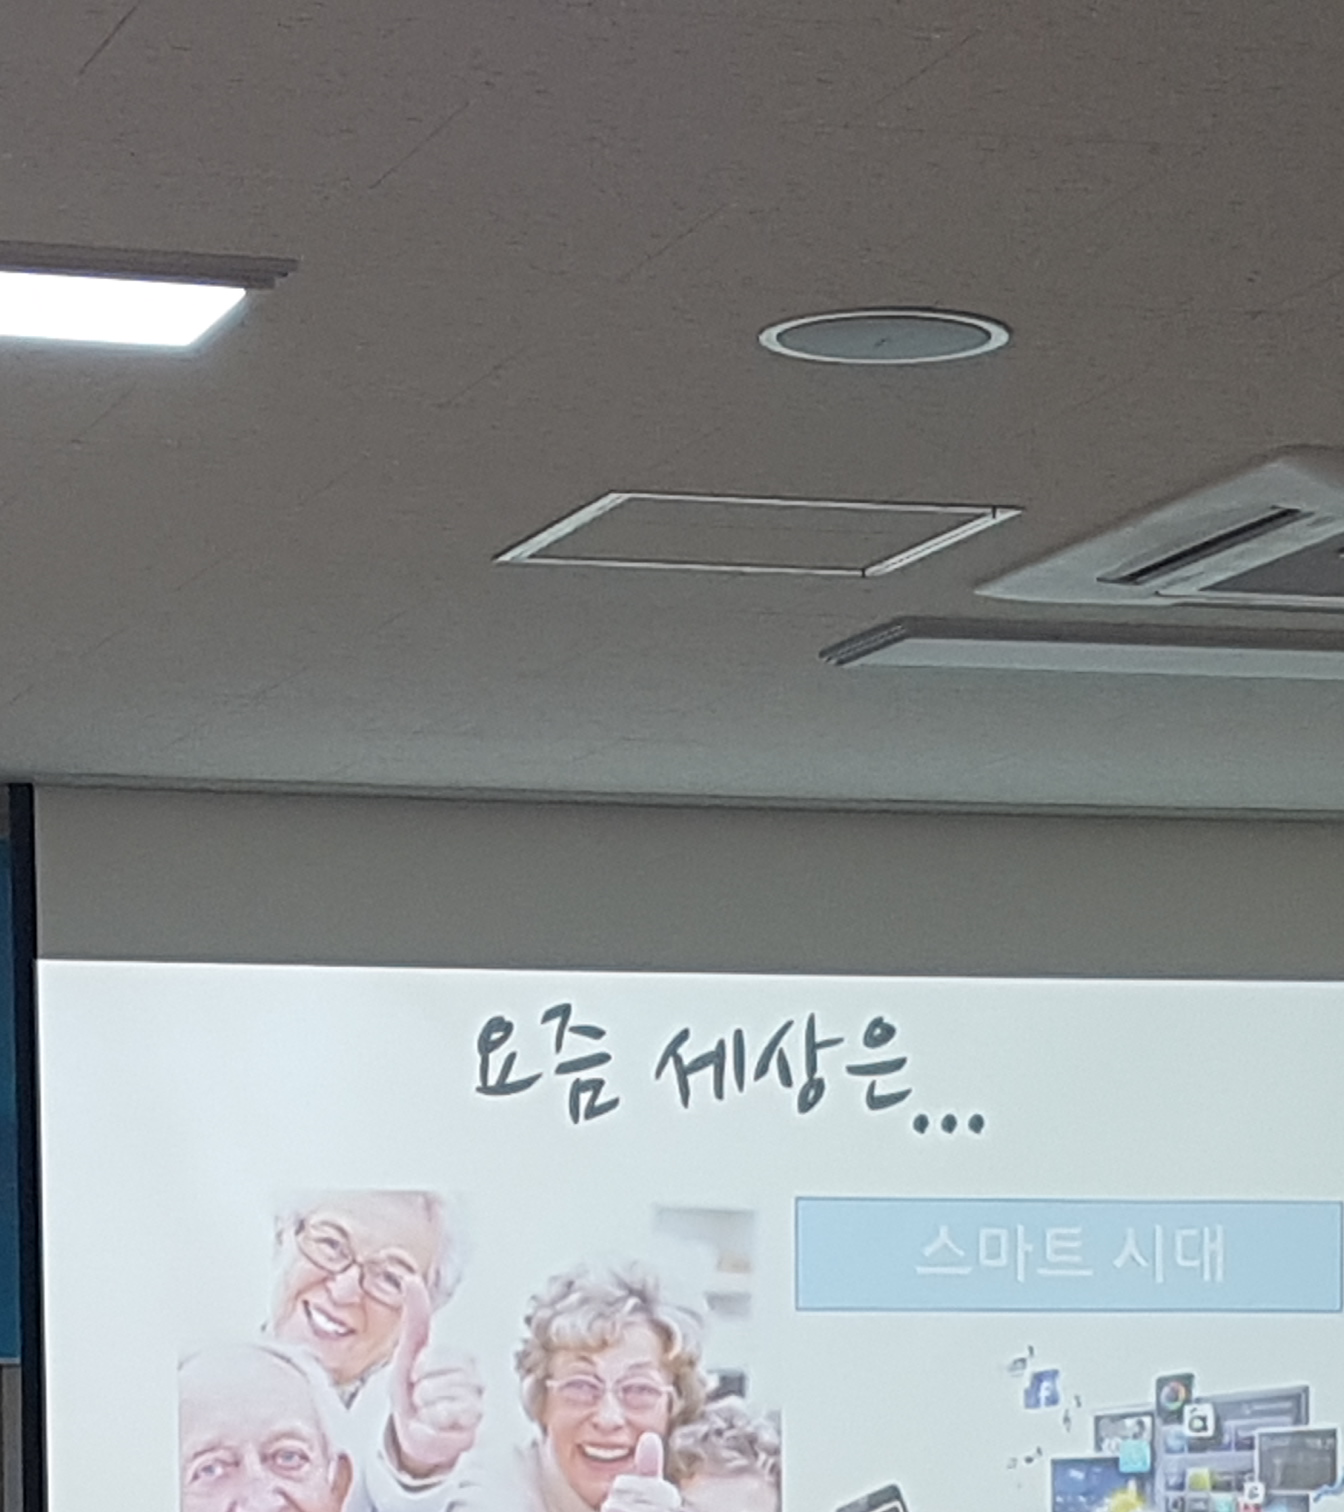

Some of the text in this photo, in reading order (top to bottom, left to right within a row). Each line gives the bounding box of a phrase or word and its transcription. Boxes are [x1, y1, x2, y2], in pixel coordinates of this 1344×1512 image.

[474, 1002, 985, 1134] 요즘 세상은...
[915, 1224, 1226, 1283] 스마트 시대
